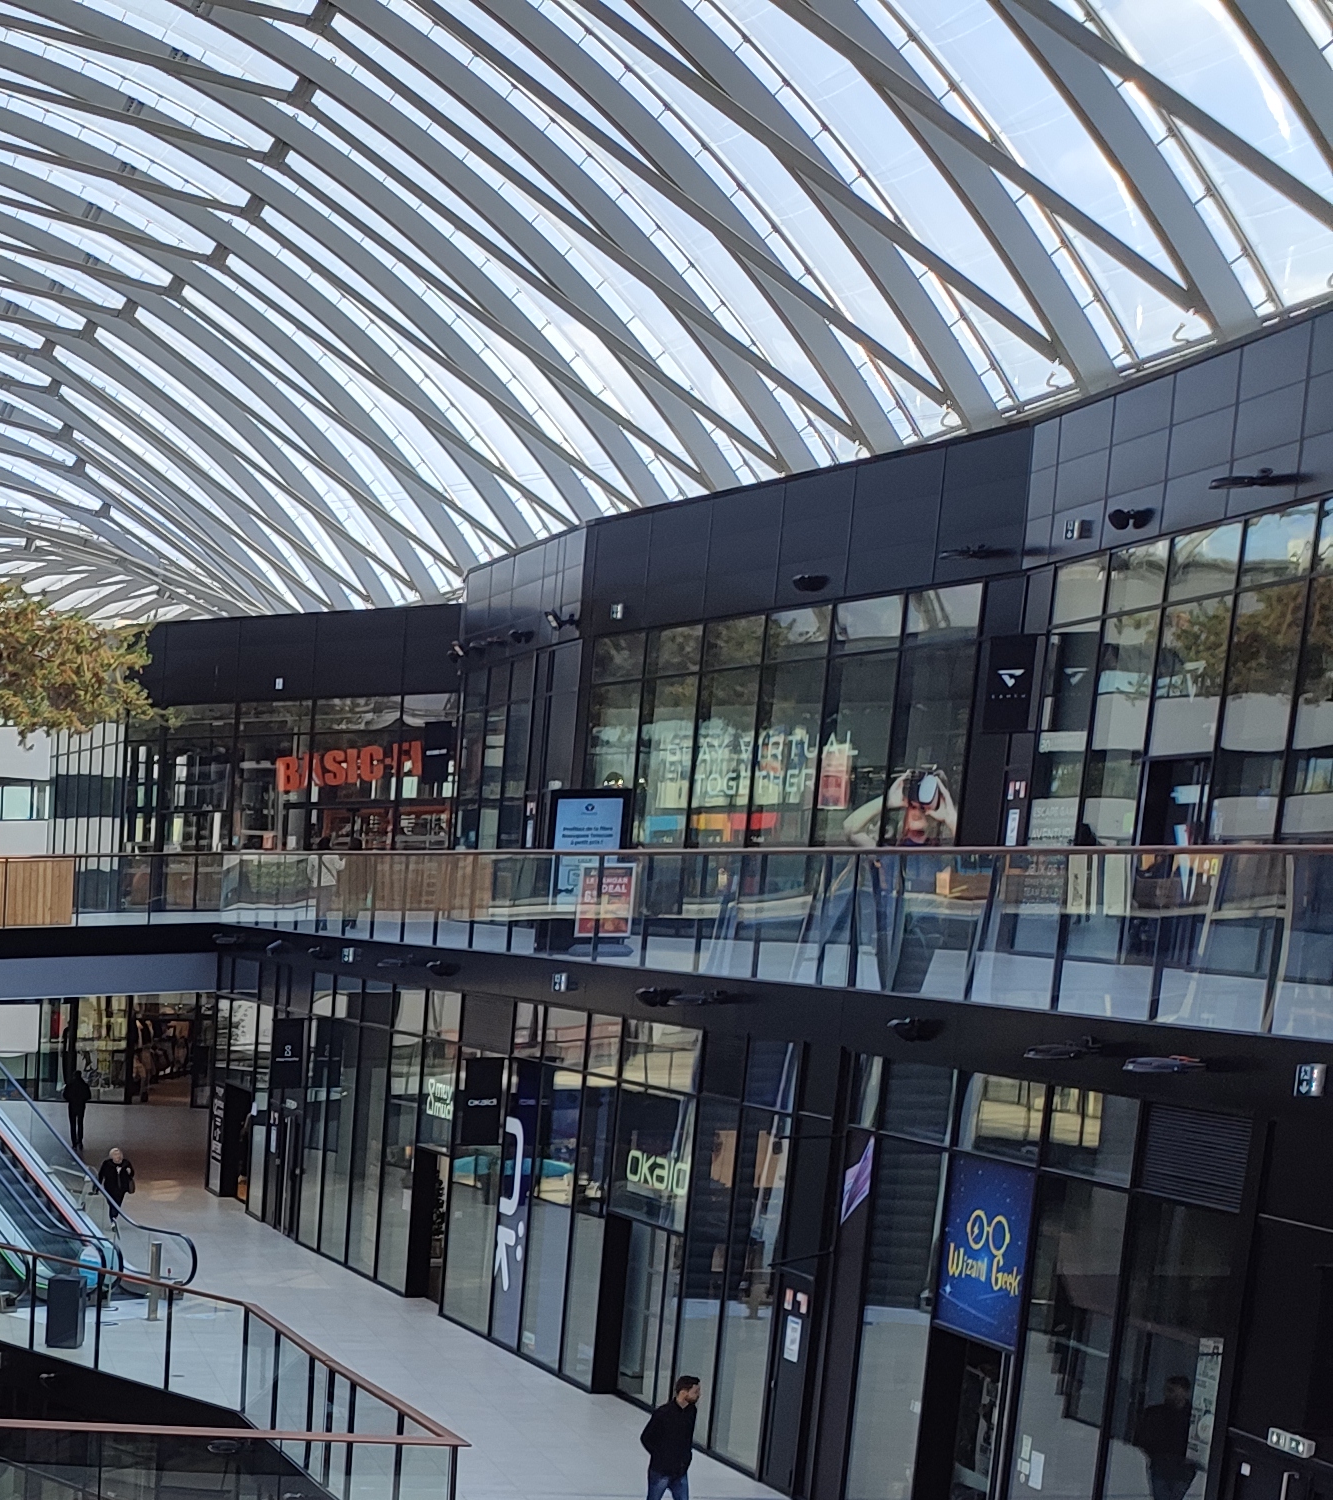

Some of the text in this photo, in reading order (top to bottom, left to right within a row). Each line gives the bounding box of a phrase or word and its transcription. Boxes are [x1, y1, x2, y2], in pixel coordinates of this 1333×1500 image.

[276, 741, 423, 792] BASIC-FI
[601, 884, 627, 893] DEAL
[948, 1242, 1021, 1297] Wizard Geek
